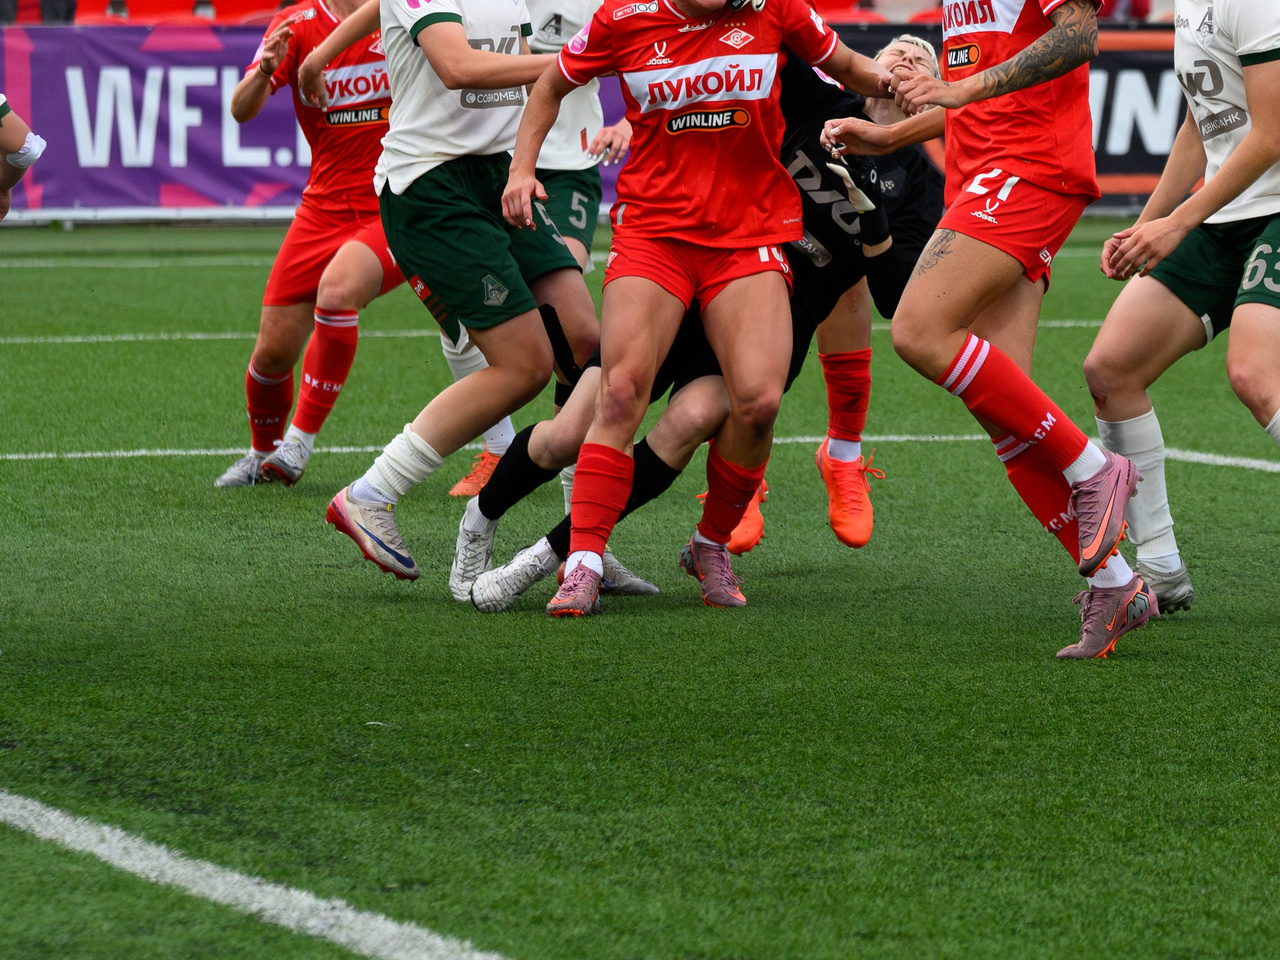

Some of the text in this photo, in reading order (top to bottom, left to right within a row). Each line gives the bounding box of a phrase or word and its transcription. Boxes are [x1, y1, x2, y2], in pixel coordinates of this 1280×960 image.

[324, 68, 390, 101] УКОЙ
[647, 63, 764, 105] ЛУКОЙЛ
[65, 66, 312, 168] WFL.
[329, 107, 379, 125] WINLINE
[672, 111, 732, 132] WINLINE
[965, 168, 1020, 202] 21
[569, 191, 589, 230] 5
